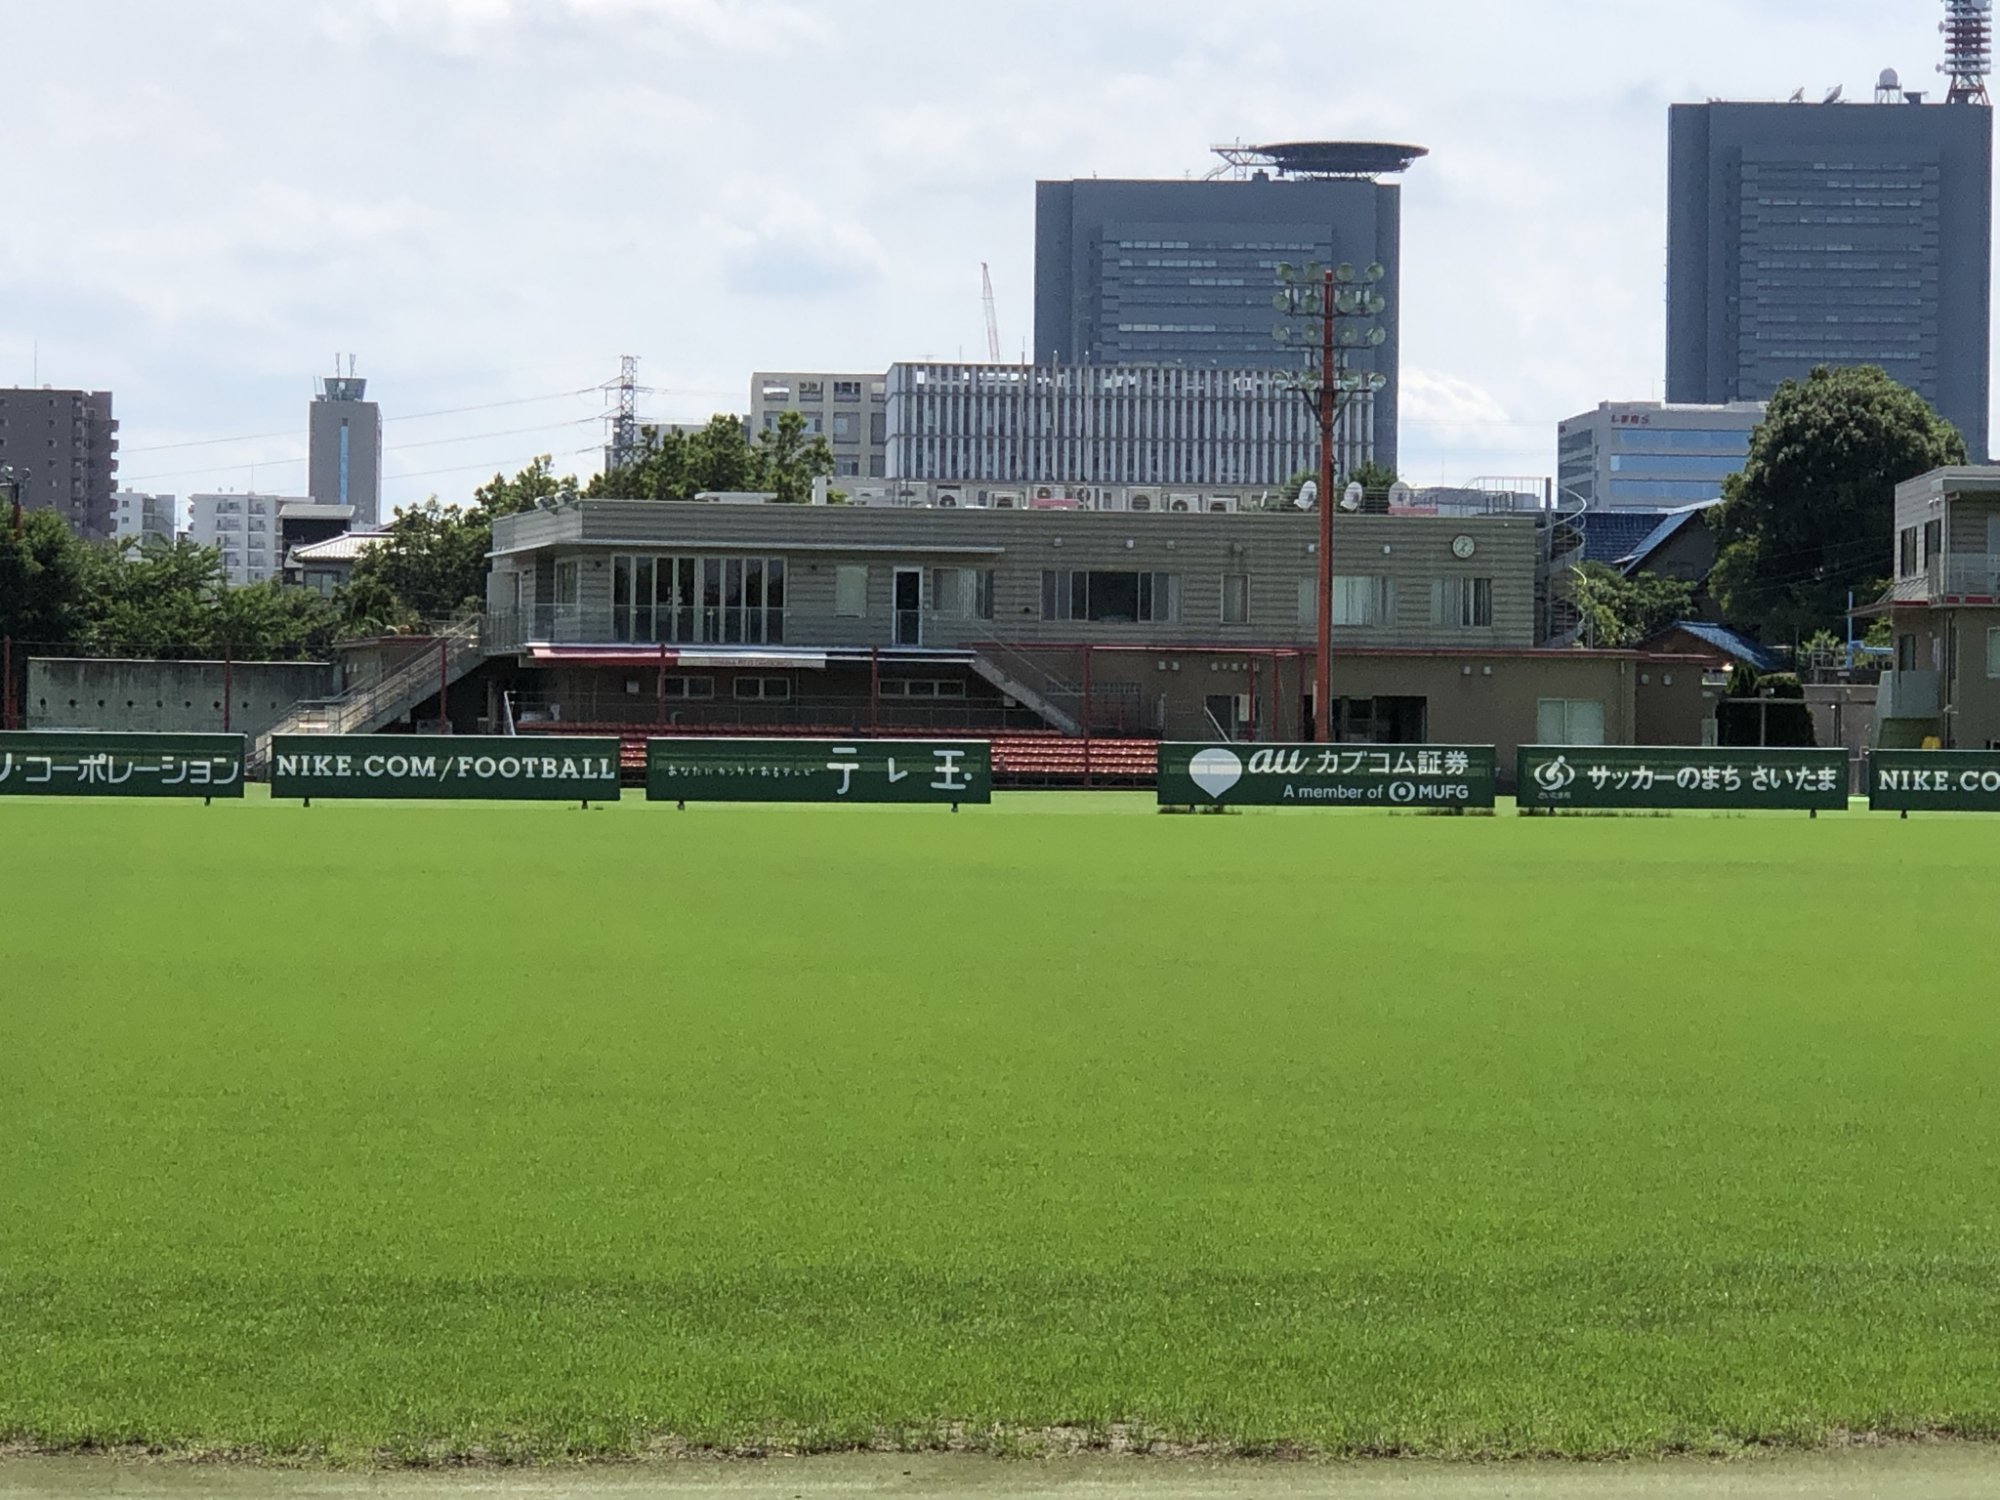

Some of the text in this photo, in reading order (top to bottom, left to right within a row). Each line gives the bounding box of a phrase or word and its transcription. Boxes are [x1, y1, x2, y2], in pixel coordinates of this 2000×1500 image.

[276, 754, 616, 783] NIKE.COM/FOOTBALL
[1247, 748, 1470, 776] au カブコム証券
[1586, 764, 1837, 791] サッカーのまち さいたま
[1878, 769, 2000, 792] NIKE.CO
[1283, 784, 1469, 800] A member of MUFG
